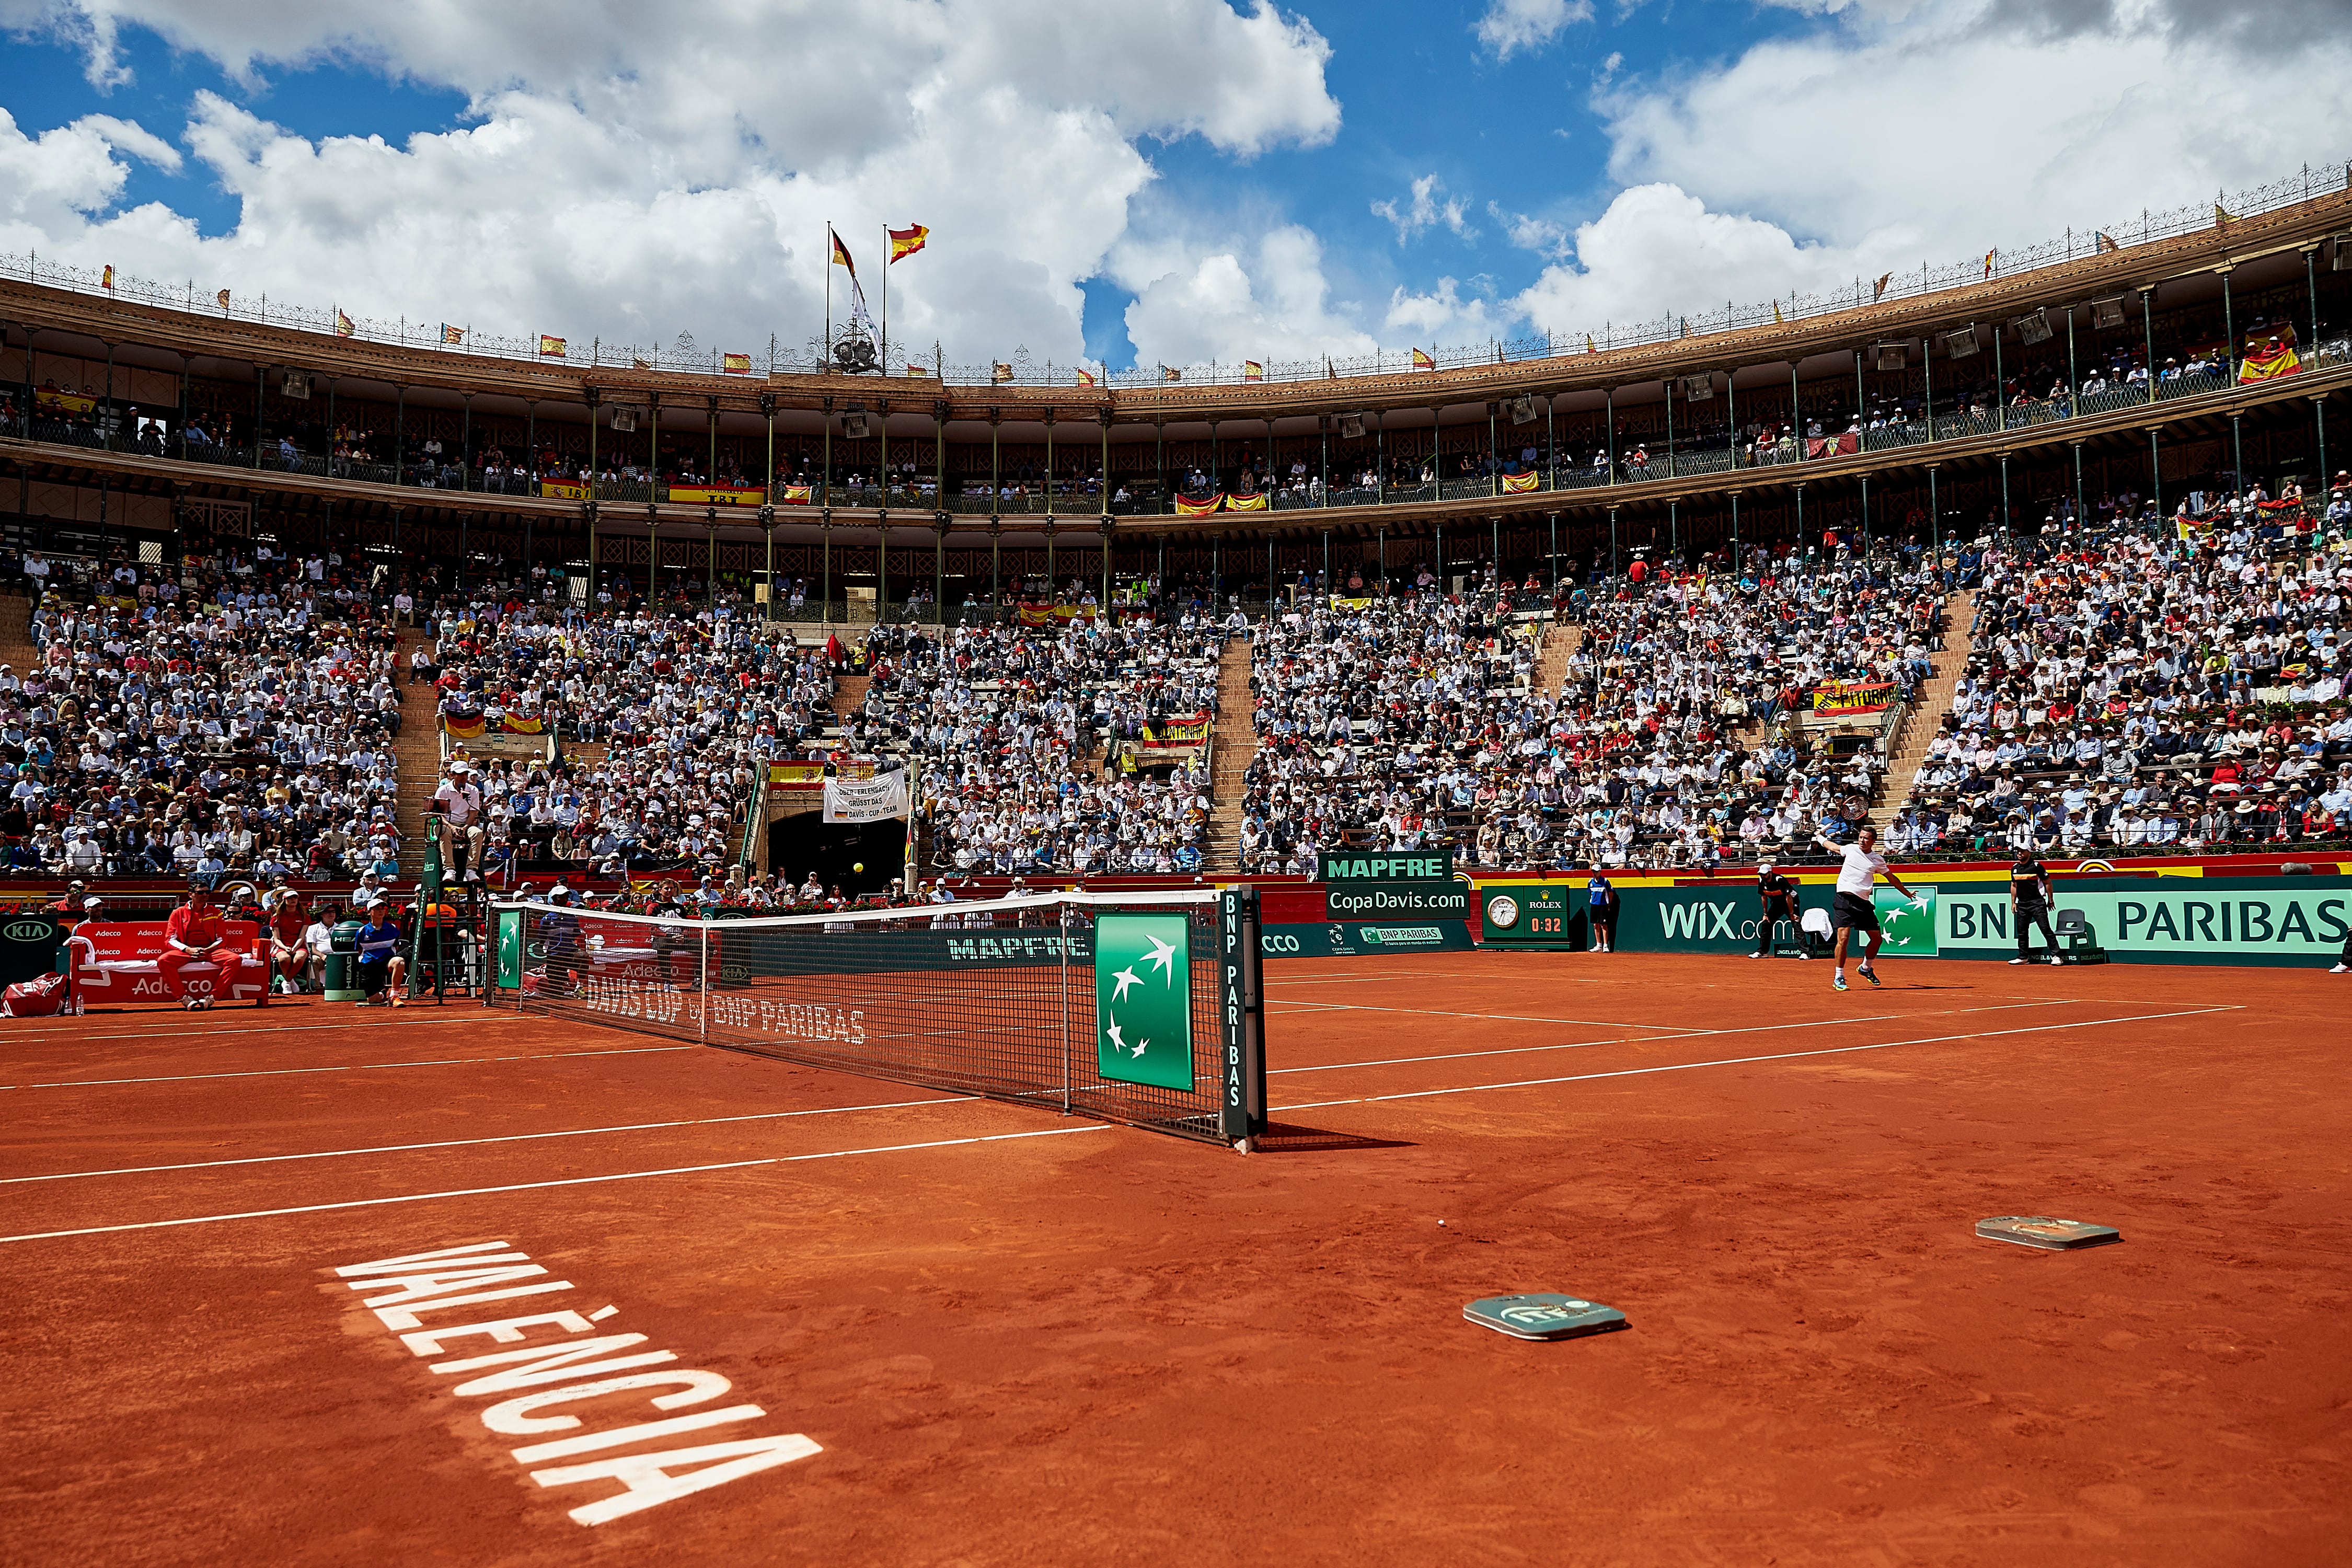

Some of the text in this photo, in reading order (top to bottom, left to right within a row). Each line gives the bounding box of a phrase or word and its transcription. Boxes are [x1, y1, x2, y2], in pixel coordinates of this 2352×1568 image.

[569, 488, 589, 498] IBI
[708, 495, 739, 505] IBI
[858, 785, 890, 794] ERLENBACH
[849, 798, 870, 806] GRÜSST
[883, 805, 897, 814] TEAM
[1328, 858, 1443, 878] MAPFRE
[1226, 895, 1236, 953] BNP
[1532, 918, 1561, 932] 0:32
[2118, 899, 2350, 943] PARIBAS
[12, 926, 44, 937] KIA
[1380, 929, 1438, 939] BNP PARIBAS
[947, 937, 1090, 960] MAPFRE
[621, 963, 679, 978] Adeco
[587, 975, 641, 1018] DAVIS
[645, 982, 682, 1024] CUP
[712, 995, 756, 1028] BNP
[760, 1000, 866, 1045] PARIBAS
[1227, 965, 1239, 1106] PARIBAS
[335, 1241, 824, 1527] VALÈNCIA
